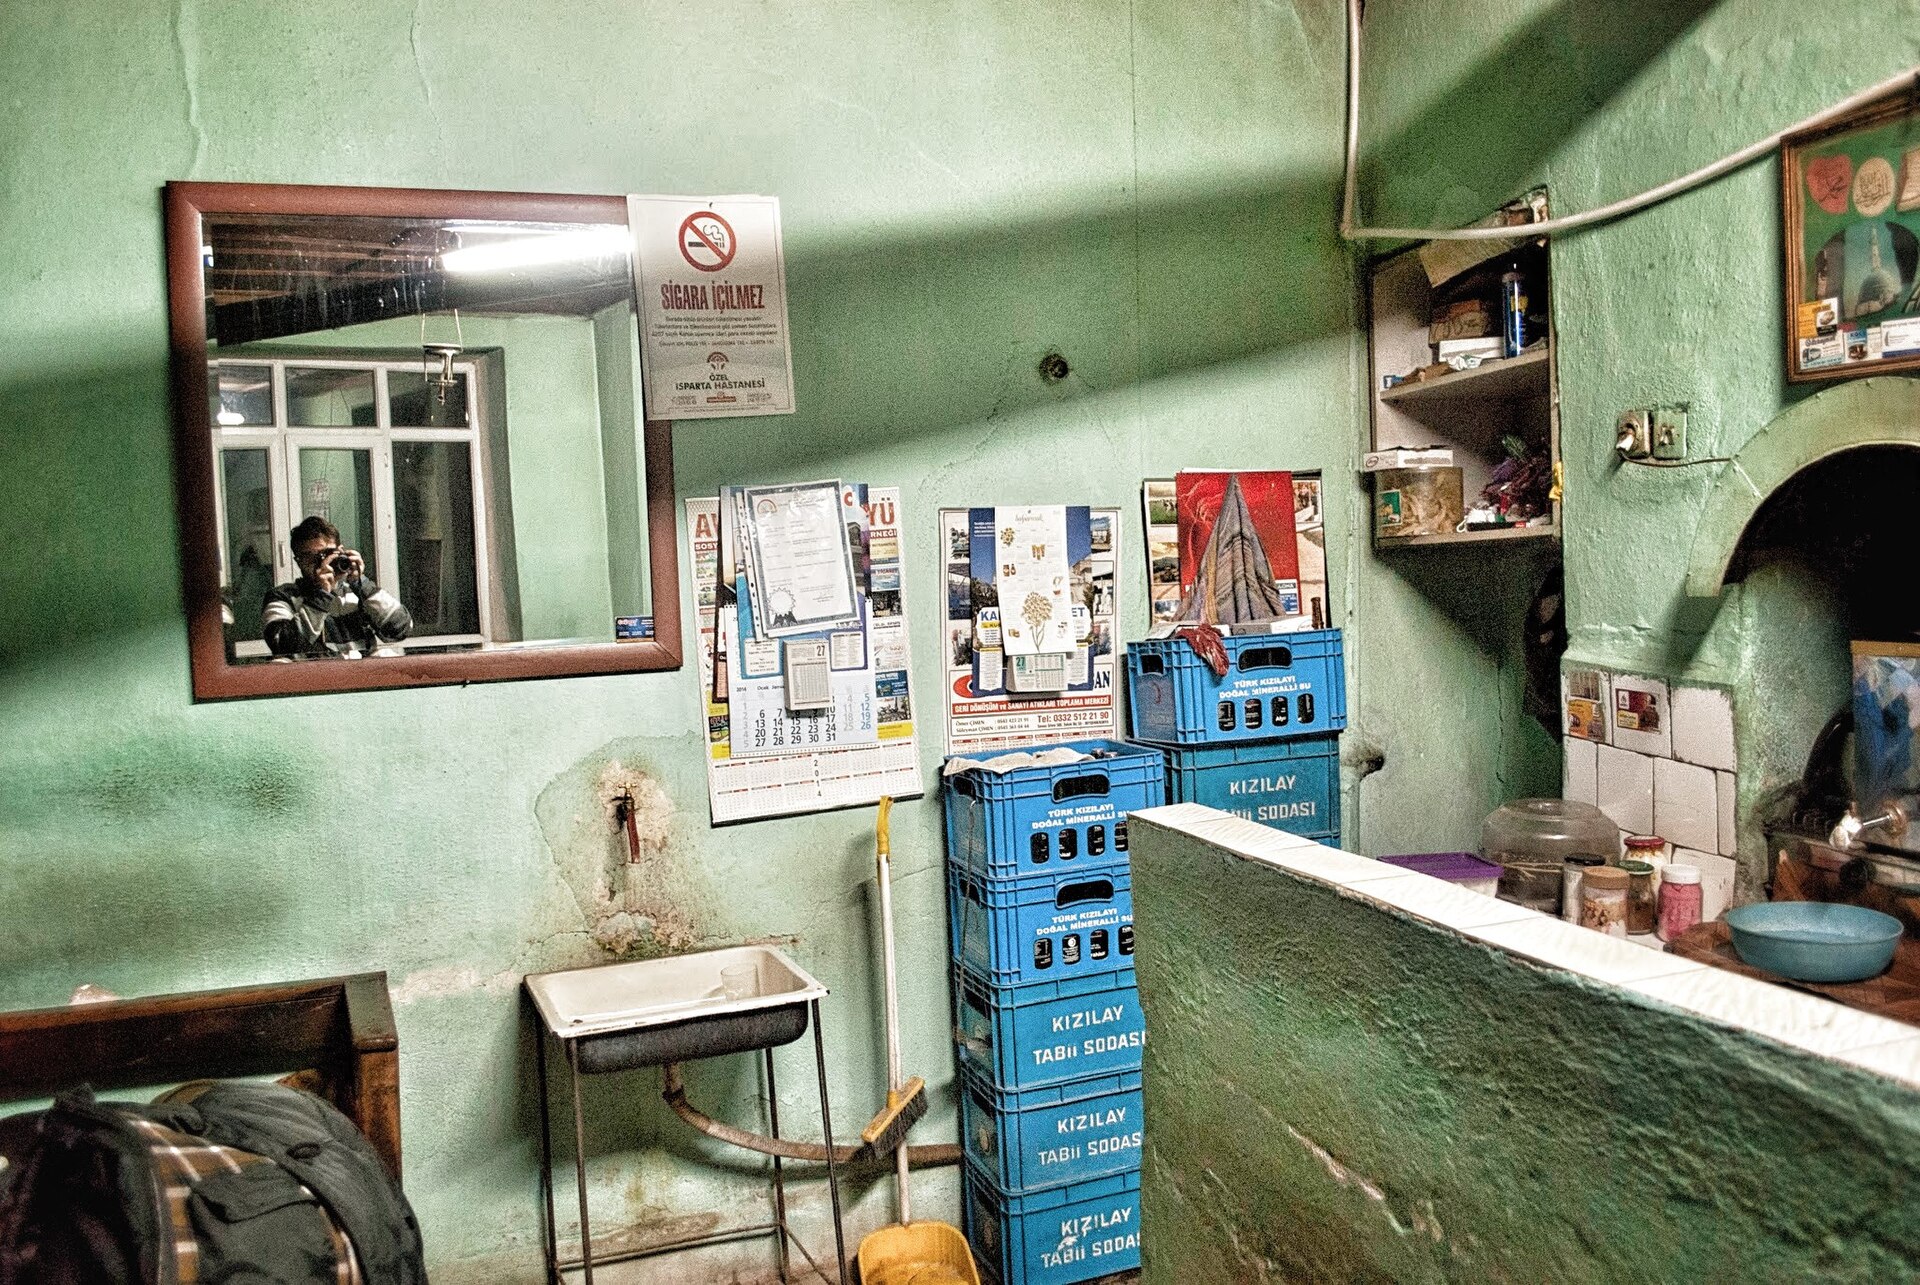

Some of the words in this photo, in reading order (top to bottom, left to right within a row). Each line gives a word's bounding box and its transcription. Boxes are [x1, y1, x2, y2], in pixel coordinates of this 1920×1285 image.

[660, 280, 709, 310] SİGARA
[711, 280, 765, 314] İÇİLMEZ
[709, 374, 728, 382] ÖZEL
[714, 378, 765, 389] HASTANESİ
[817, 645, 825, 656] 27
[1016, 656, 1026, 667] 27
[1233, 680, 1258, 689] TÜRK
[1260, 675, 1296, 685] KIZILAYI
[864, 693, 870, 701] 5
[1219, 689, 1249, 699] DOĞAL
[759, 710, 765, 719] 6
[777, 709, 783, 717] 7
[861, 703, 870, 711] 12
[955, 704, 969, 713] GERİ
[970, 702, 999, 713] DÖNÜŞÜM
[1057, 698, 1084, 706] TOPLAMA
[755, 720, 766, 728] 13
[773, 718, 783, 727] 14
[791, 717, 801, 725] 15
[808, 716, 818, 724] 16
[826, 715, 835, 723] 17
[861, 712, 871, 720] 19
[1038, 715, 1051, 723] Tel:
[1053, 713, 1071, 721] 0332
[755, 729, 766, 738] 20
[773, 728, 783, 736] 21
[791, 726, 801, 735] 22
[808, 725, 819, 733] 23
[826, 724, 836, 732] 24
[861, 721, 871, 730] 26
[755, 738, 766, 747] 27
[773, 737, 784, 746] 28
[791, 735, 801, 744] 29
[808, 735, 819, 743] 30
[826, 733, 836, 741] 31
[1229, 774, 1296, 795] KIZILAY
[1048, 808, 1073, 818] TÜRK
[1076, 803, 1114, 814] KIZILAYI
[1258, 801, 1315, 821] SODASI
[1032, 818, 1064, 829] DOĞAL
[1066, 810, 1115, 824] MİNERALLİ
[1052, 914, 1077, 924] TÜRK
[1080, 908, 1118, 919] KIZILAYI
[1036, 924, 1068, 936] DOĞAL
[1070, 916, 1119, 930] MİNERALLİ
[1052, 1004, 1124, 1032] KIZILAY
[1084, 1030, 1146, 1057] SODASI
[1057, 1107, 1126, 1134] KIZILAY
[1061, 1207, 1132, 1236] KIZILAY
